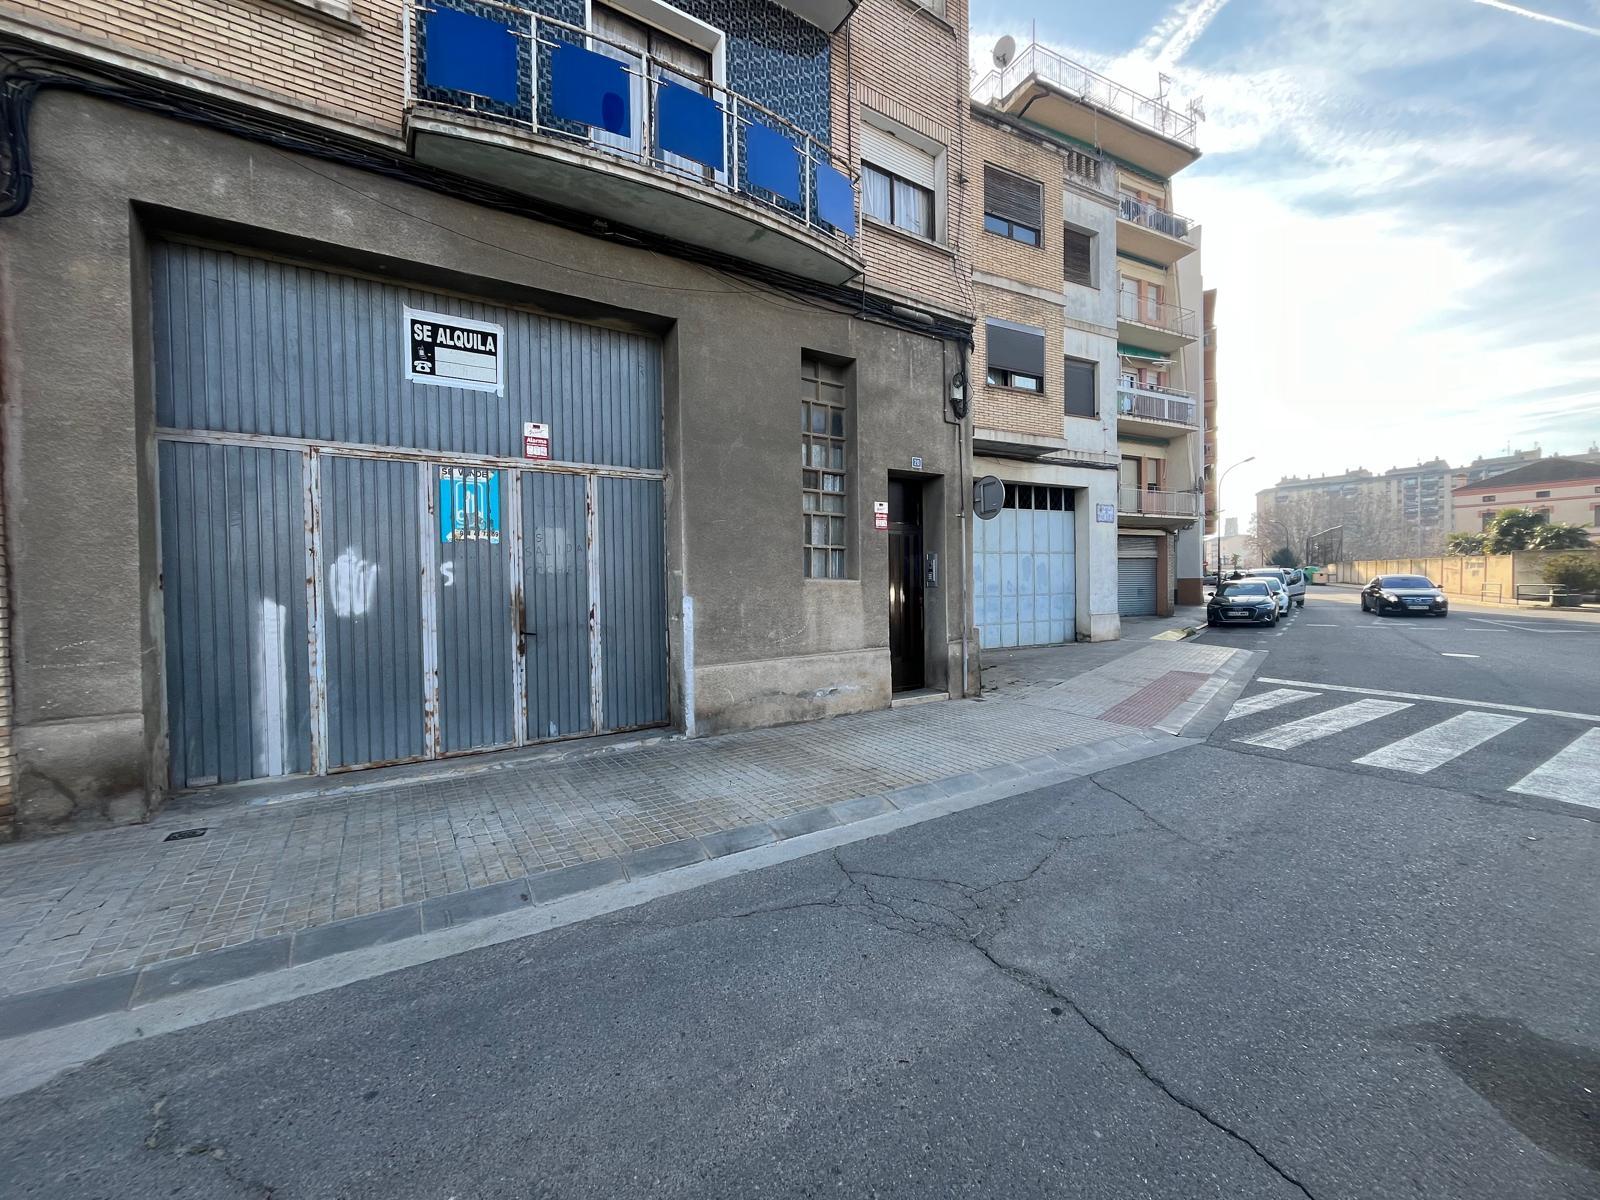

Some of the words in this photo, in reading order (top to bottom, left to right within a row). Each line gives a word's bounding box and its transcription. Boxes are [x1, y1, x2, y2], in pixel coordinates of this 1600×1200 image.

[413, 323, 433, 342] SE
[436, 327, 496, 353] ALQUILA
[526, 436, 548, 445] Alarma
